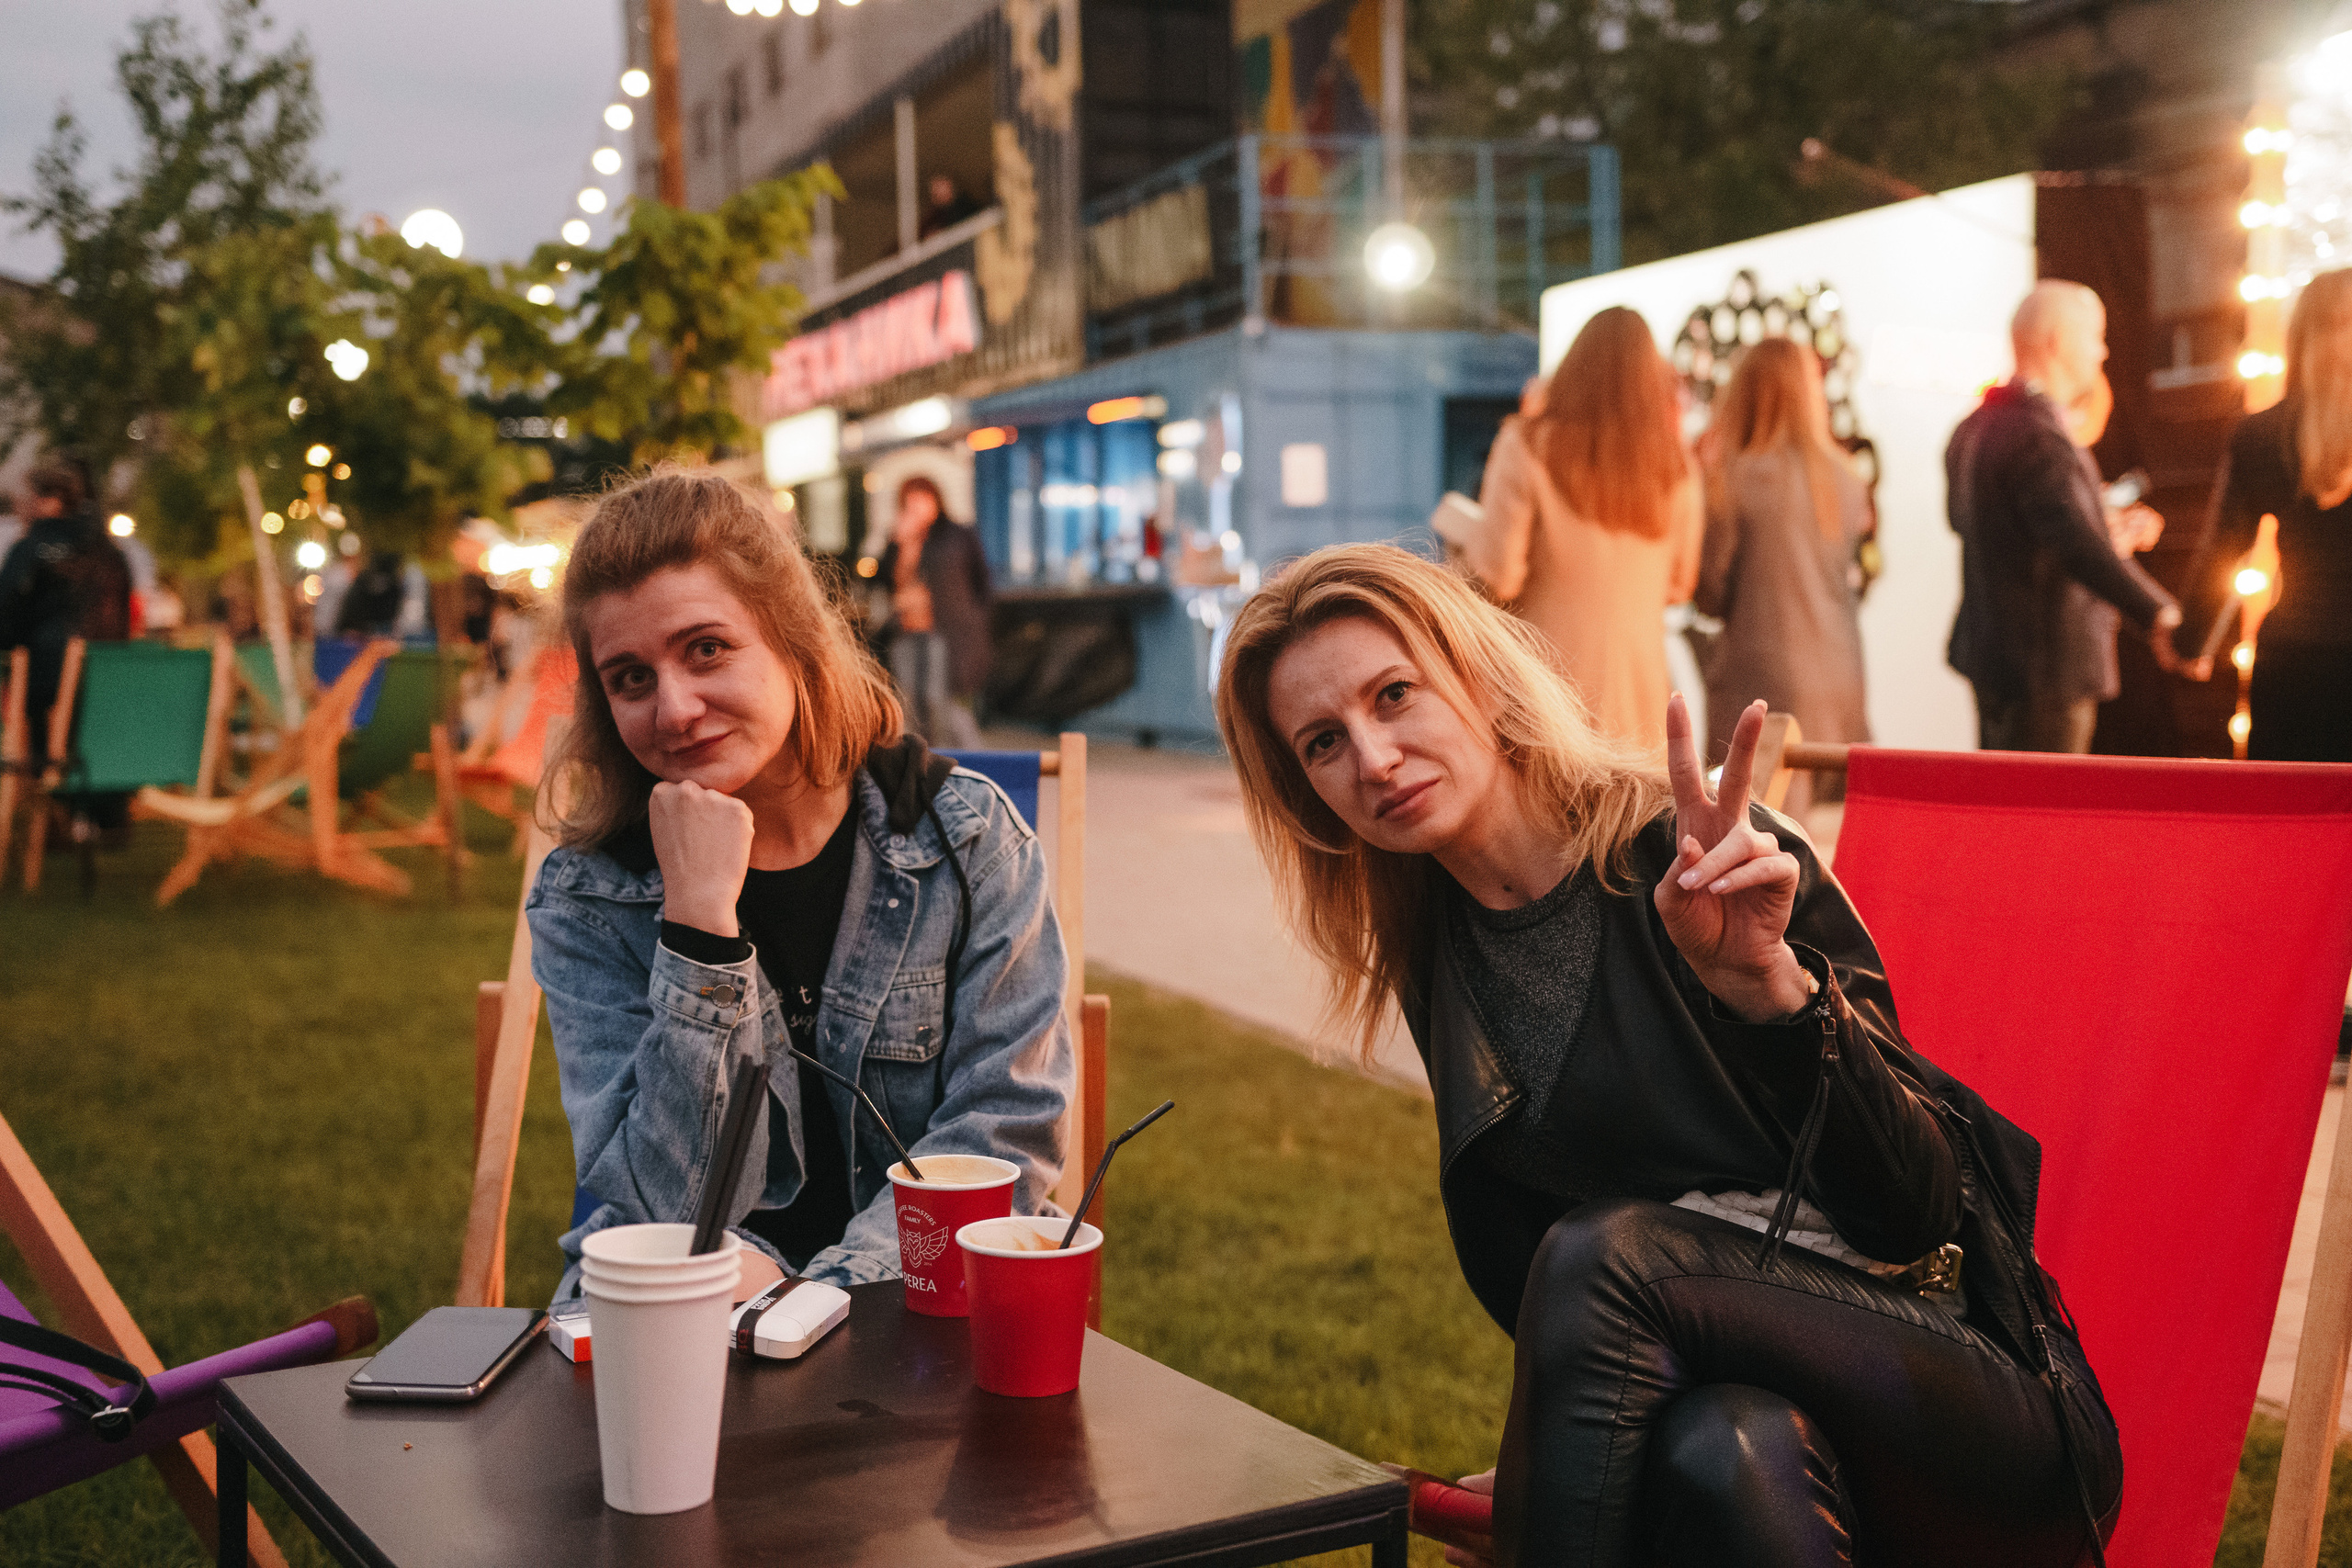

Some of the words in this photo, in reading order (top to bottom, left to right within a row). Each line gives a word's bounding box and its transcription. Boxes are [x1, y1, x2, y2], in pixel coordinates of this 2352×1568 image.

[904, 1214, 922, 1224] FAMILY
[908, 1204, 936, 1226] ROASTERS
[903, 1270, 937, 1292] PEREA
